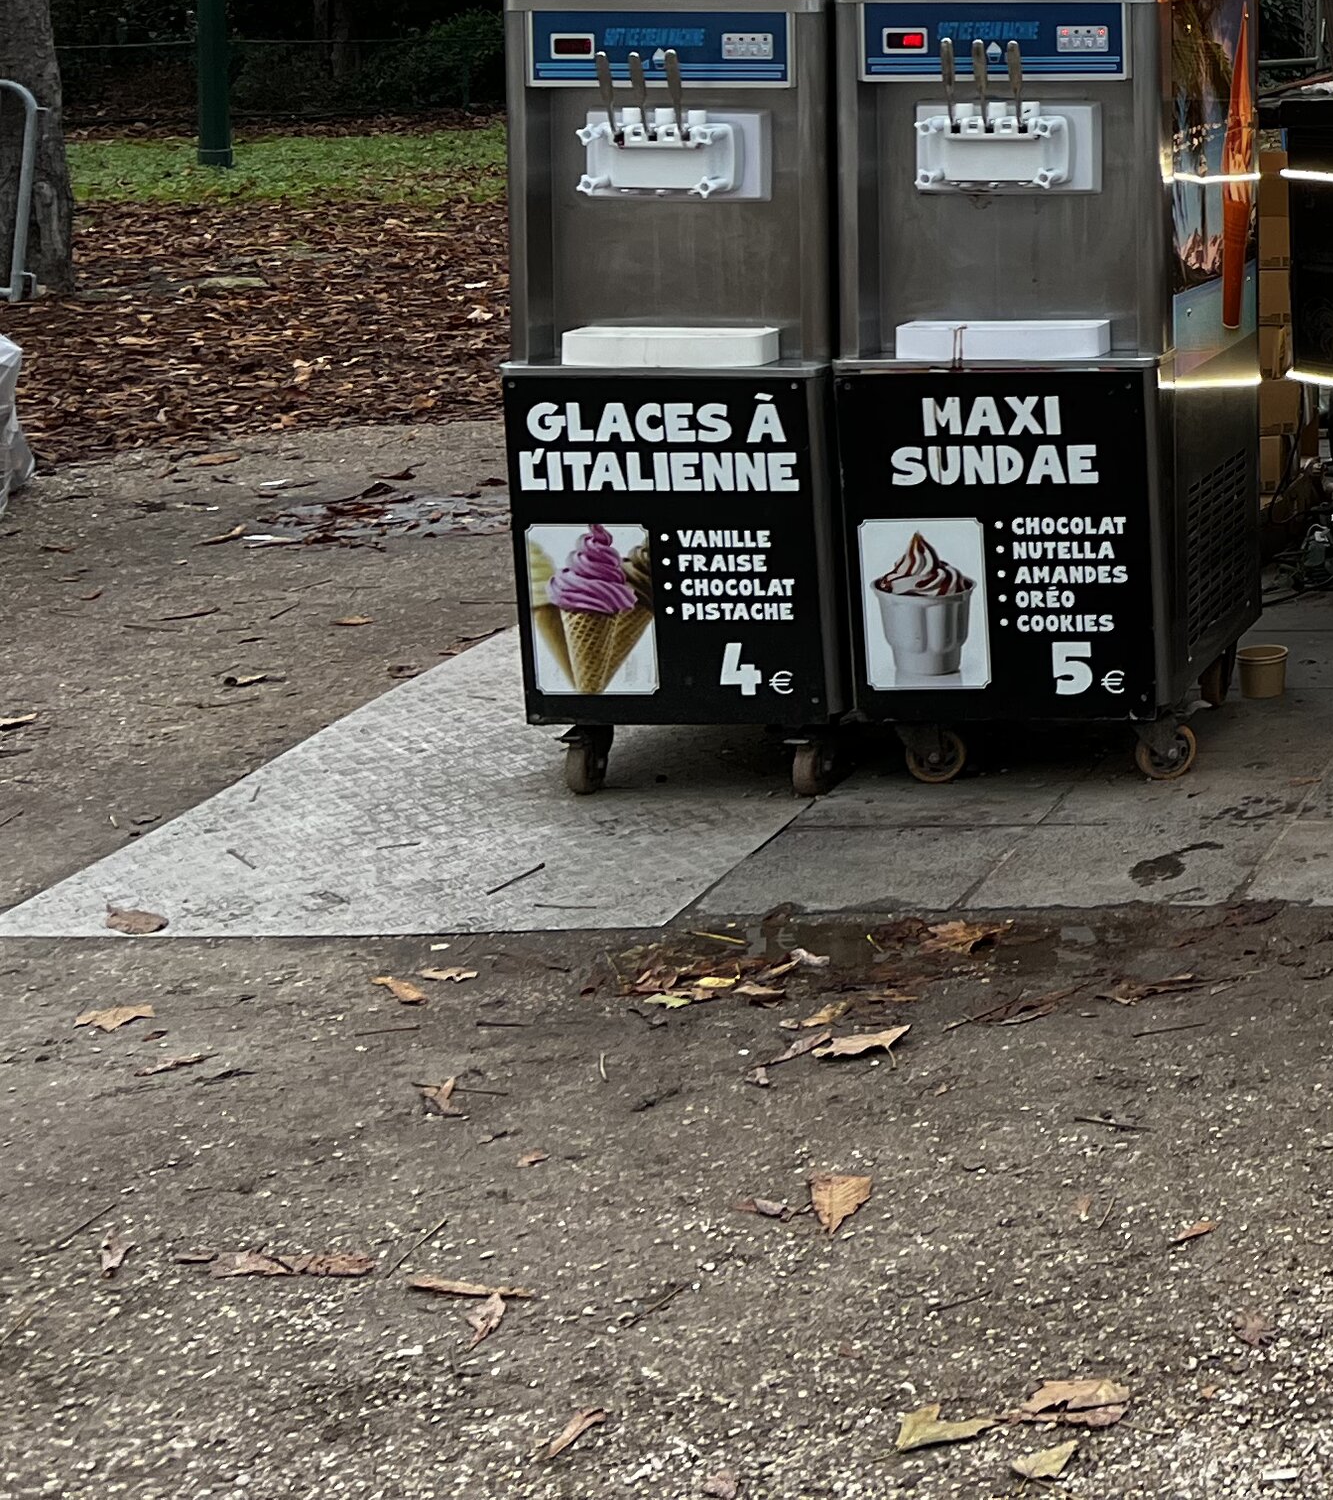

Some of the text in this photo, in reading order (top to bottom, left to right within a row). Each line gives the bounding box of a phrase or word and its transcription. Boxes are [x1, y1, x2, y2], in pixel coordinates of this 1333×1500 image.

[526, 392, 786, 443] GLACES À
[922, 395, 1062, 438] MAXI
[518, 446, 799, 493] L'ITALIENNE
[890, 444, 1099, 487] SUNDAE
[1011, 516, 1127, 536] CHOCOLAT
[677, 529, 772, 549] VANILLE
[1012, 540, 1115, 560] NUTELLA
[678, 554, 768, 573] FRAISE
[1013, 564, 1129, 585] AMANDES
[679, 577, 795, 598] CHOCOLAT
[1014, 585, 1076, 609] ORÉO
[681, 602, 795, 622] PISTACHE
[1015, 613, 1114, 634] COOKIES
